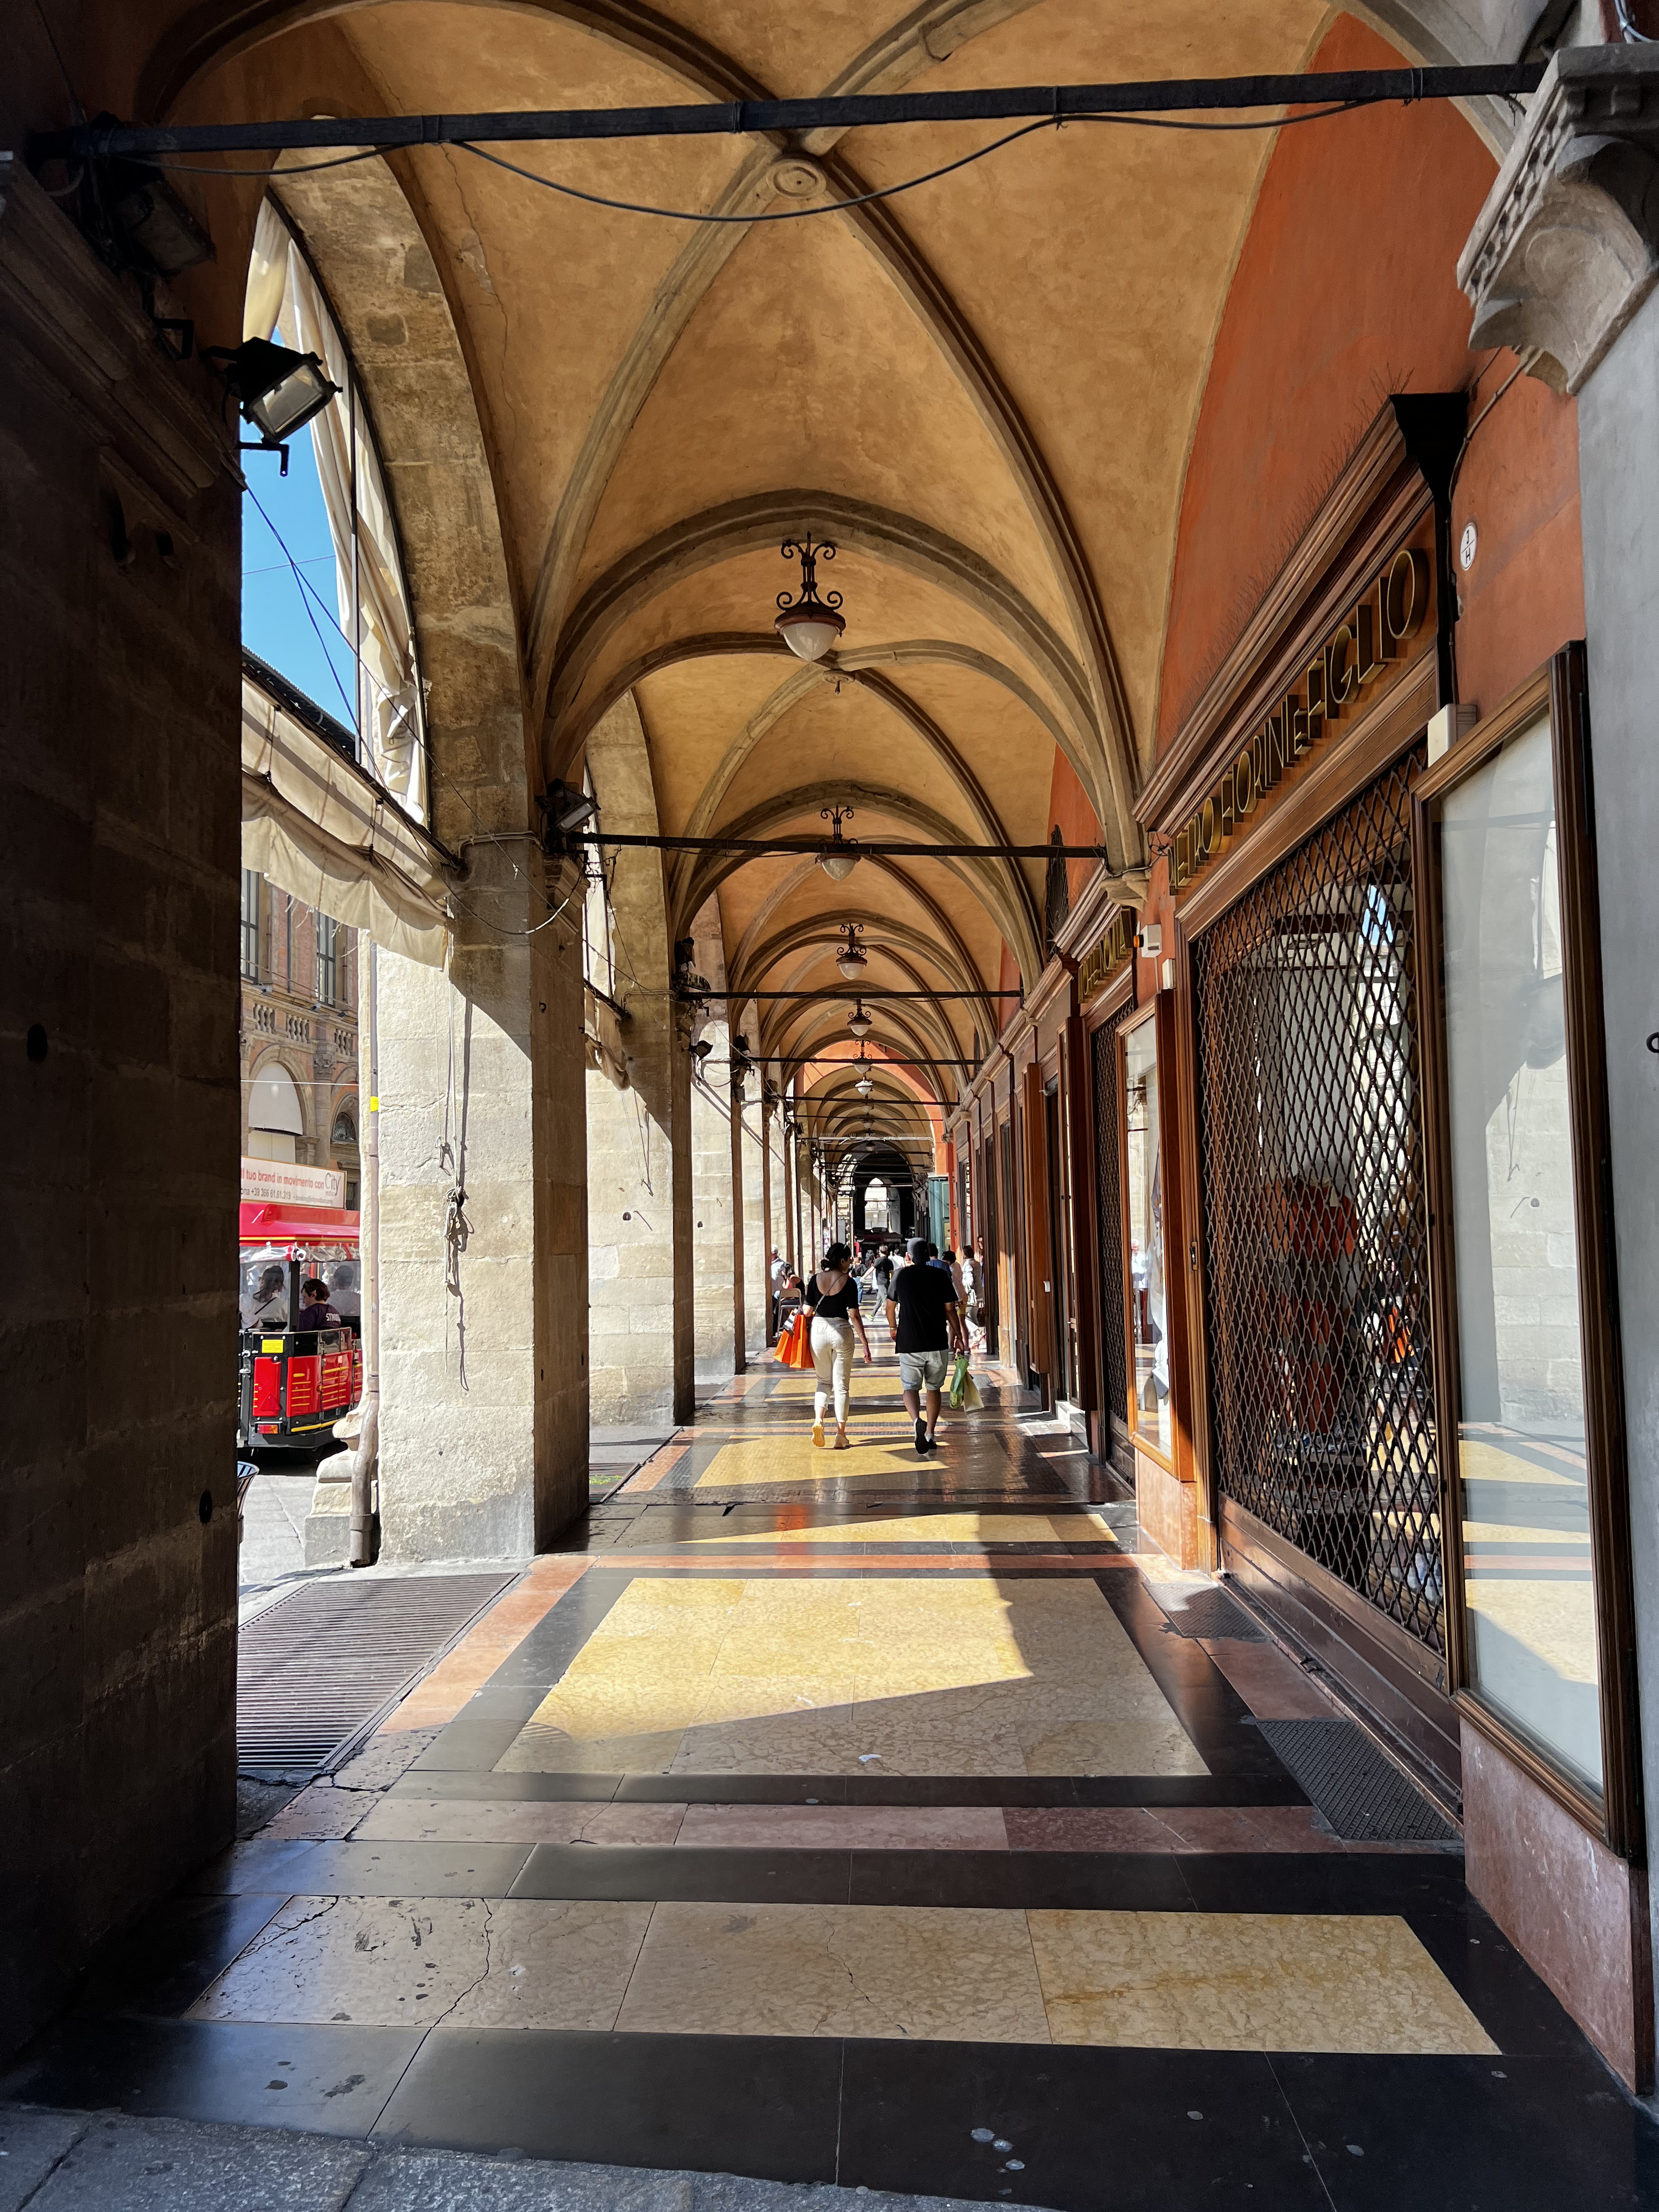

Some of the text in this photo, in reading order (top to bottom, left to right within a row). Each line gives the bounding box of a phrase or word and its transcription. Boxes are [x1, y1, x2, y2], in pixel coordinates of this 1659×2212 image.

[1465, 546, 1471, 565] H
[1167, 797, 1222, 895] PIETRO
[1221, 695, 1300, 836] FIORINI
[1307, 549, 1428, 739] FIGLIO
[246, 1169, 257, 1181] tuo
[258, 1170, 275, 1183] brand
[277, 1172, 282, 1184] in
[284, 1175, 314, 1188] movimento
[315, 1181, 324, 1190] con
[325, 1172, 340, 1196] City
[251, 1187, 260, 1197] +39
